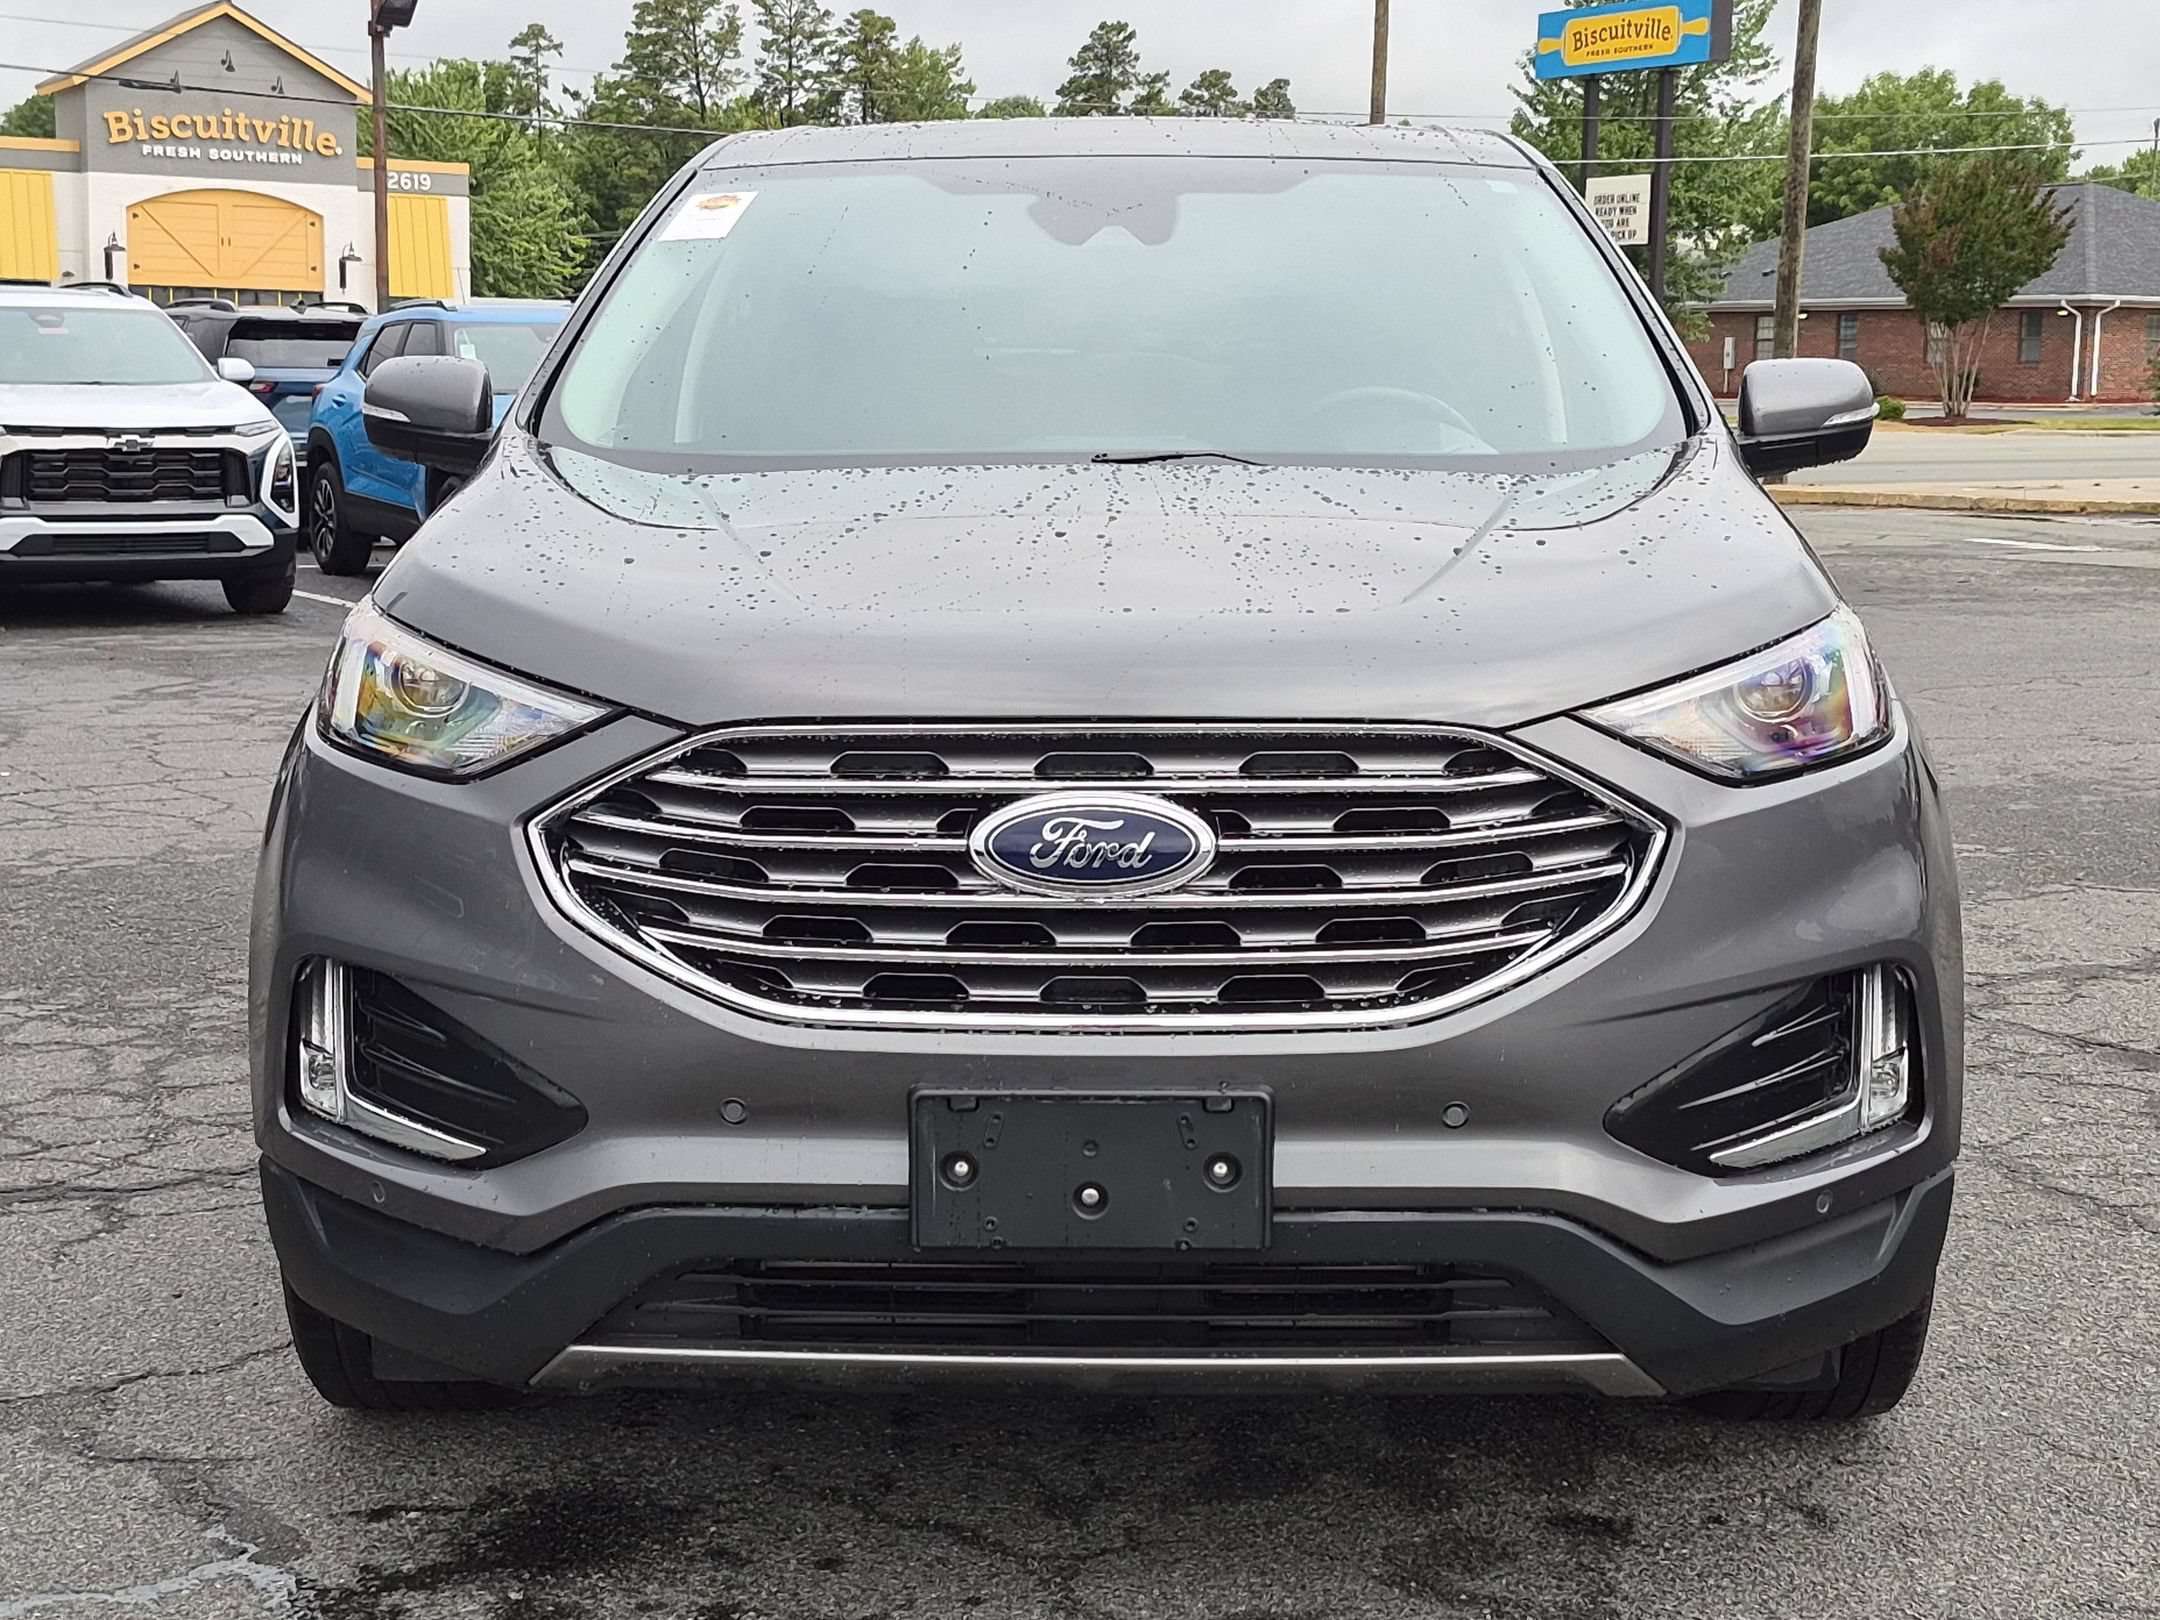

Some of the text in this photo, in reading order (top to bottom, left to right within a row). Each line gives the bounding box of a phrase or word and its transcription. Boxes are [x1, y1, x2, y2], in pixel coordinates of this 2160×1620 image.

[1572, 18, 1671, 53] Biscuitville
[1586, 44, 1654, 57] FRESH SOUTHERN
[104, 108, 339, 156] Biscuitville
[142, 144, 303, 165] FRESH SOUTHERN
[387, 172, 433, 191] 2619
[1594, 193, 1640, 205] ORDER ONLINE
[1595, 206, 1637, 216] READY WHEN
[1616, 218, 1630, 227] ARE
[1627, 230, 1637, 239] UP
[1029, 817, 1155, 868] Ford
